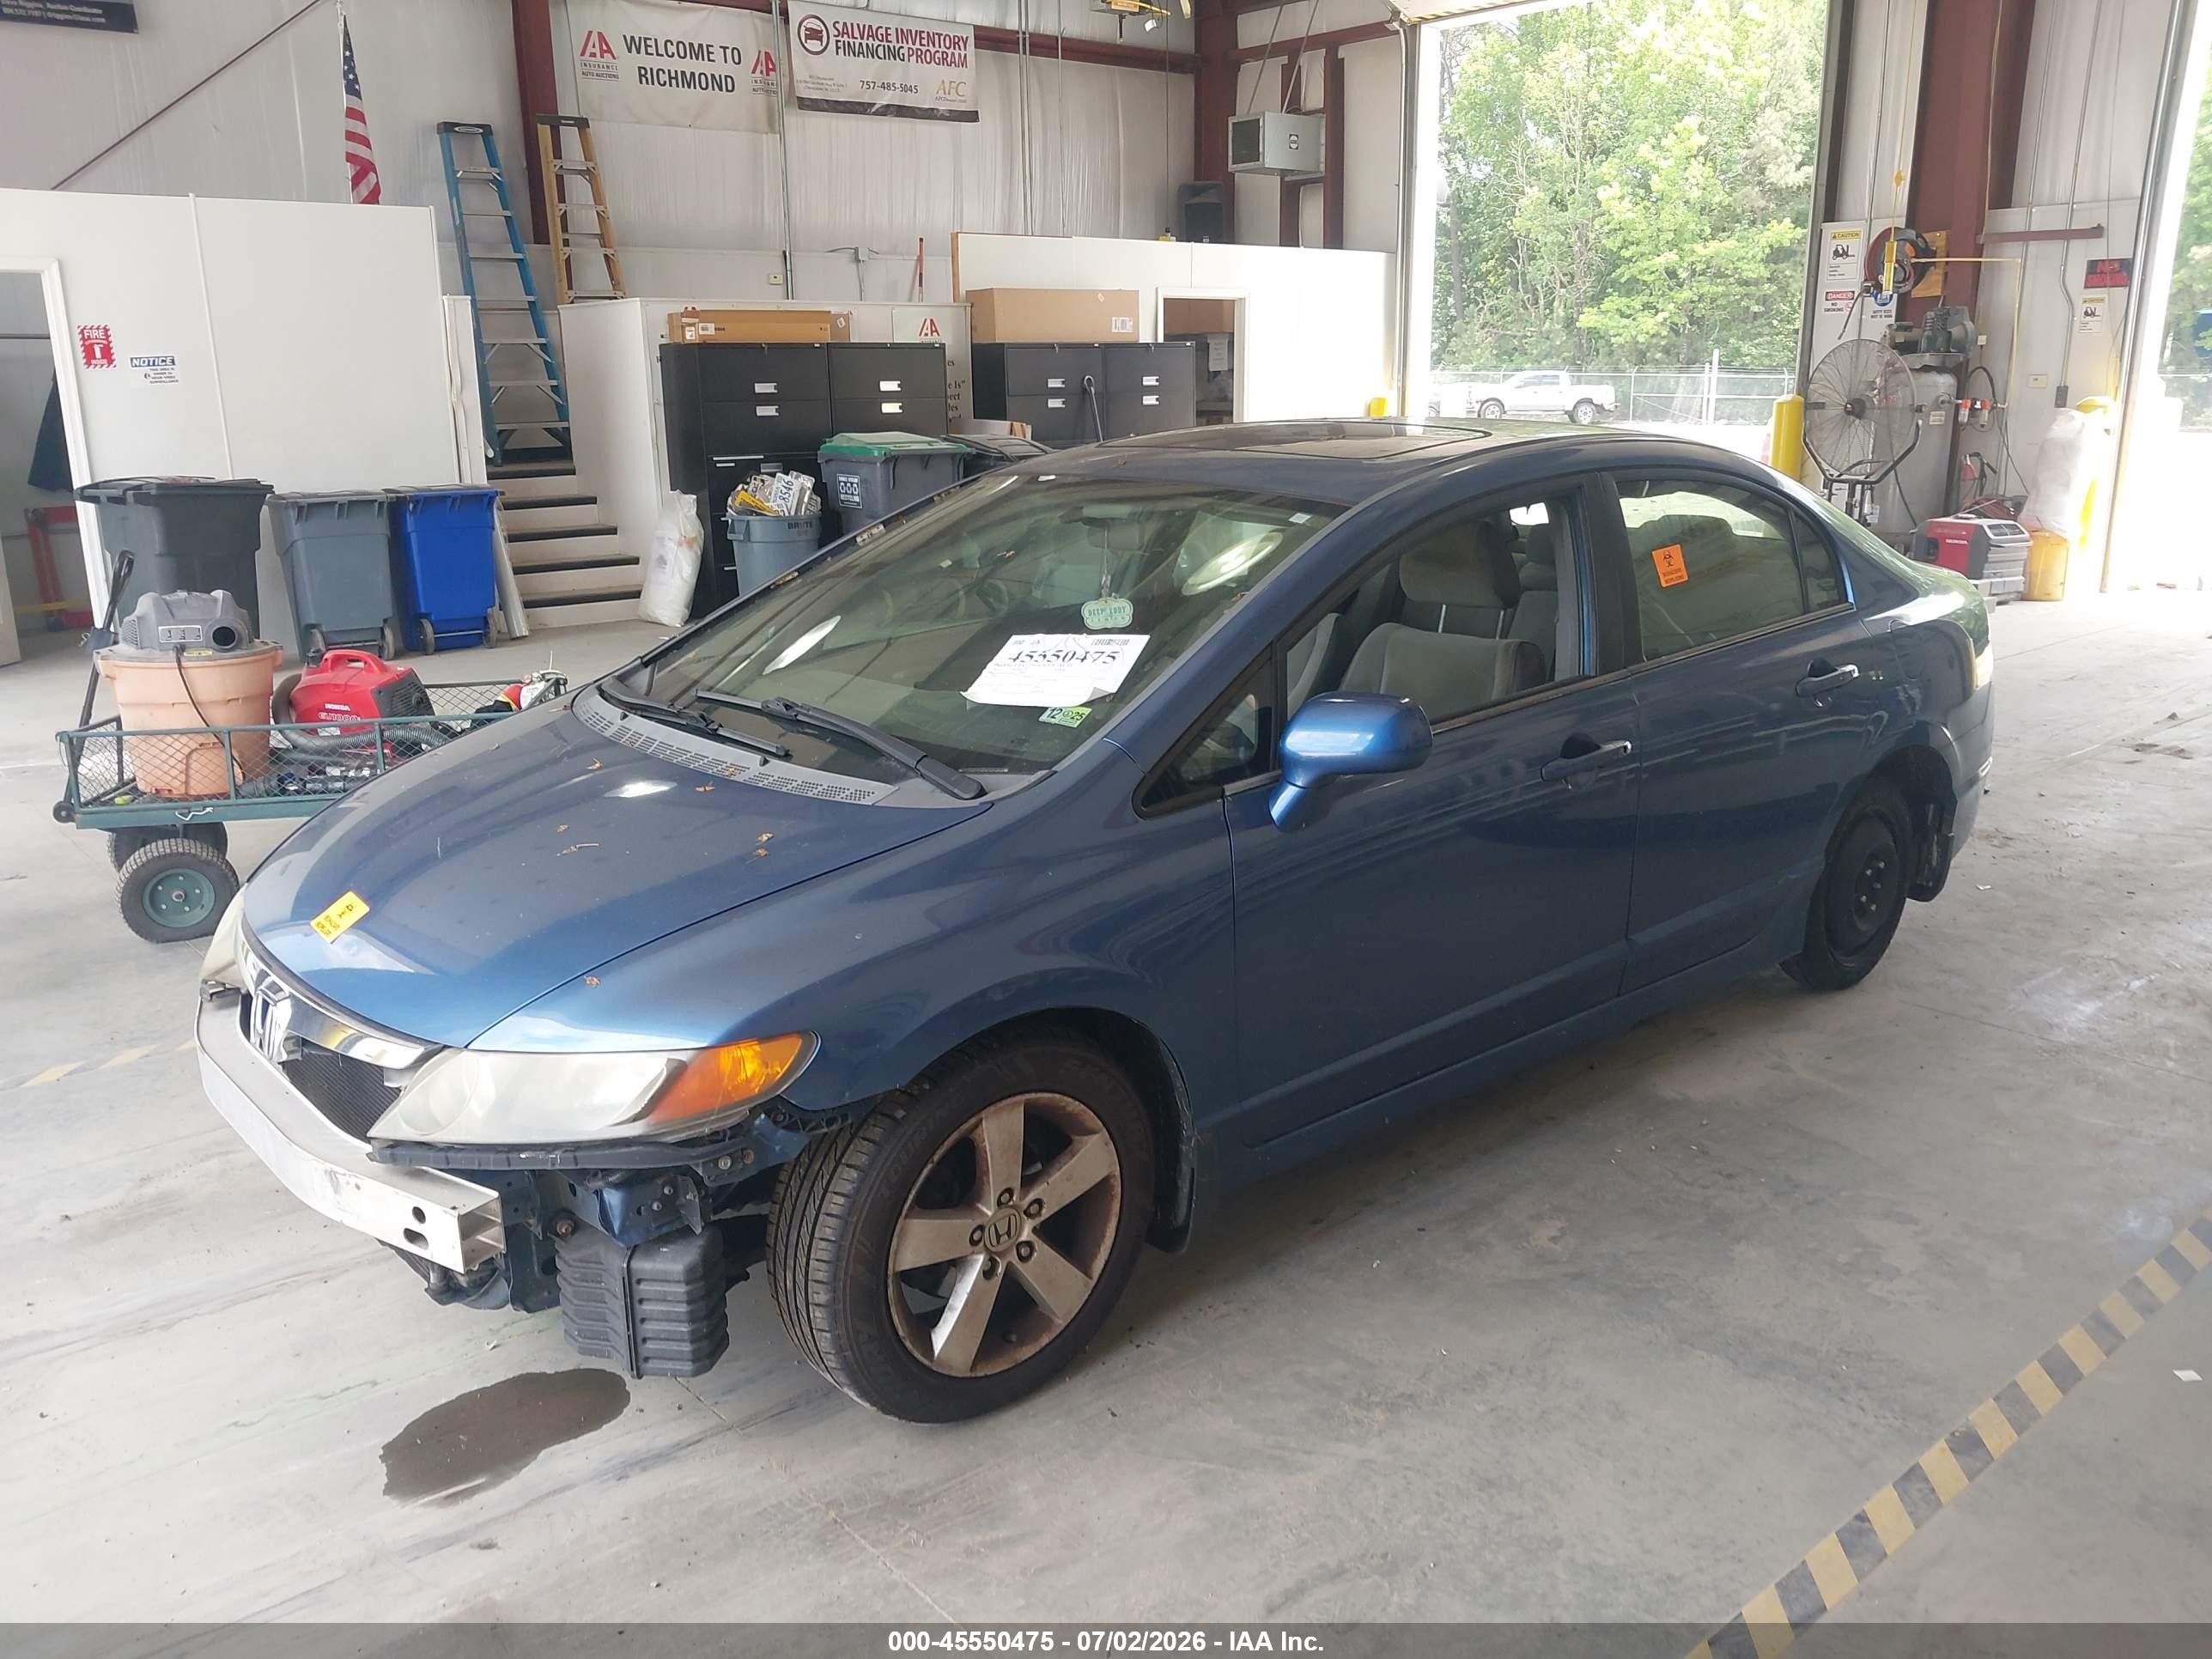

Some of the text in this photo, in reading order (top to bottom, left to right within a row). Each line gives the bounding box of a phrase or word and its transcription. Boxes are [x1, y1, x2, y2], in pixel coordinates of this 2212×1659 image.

[832, 21, 969, 52] SALVAGE INVENTORY
[622, 33, 742, 65] WELCOME TO
[835, 40, 969, 69] FINANCING PROGRAM
[637, 65, 736, 93] RICHMOND
[859, 80, 919, 94] 757-485-5045
[935, 80, 967, 97] AFC
[83, 329, 106, 339] FIRE
[132, 356, 173, 367] NOTICE
[1008, 650, 1120, 665] 45550475
[325, 703, 350, 712] HONDA
[1047, 707, 1086, 721] 12 25
